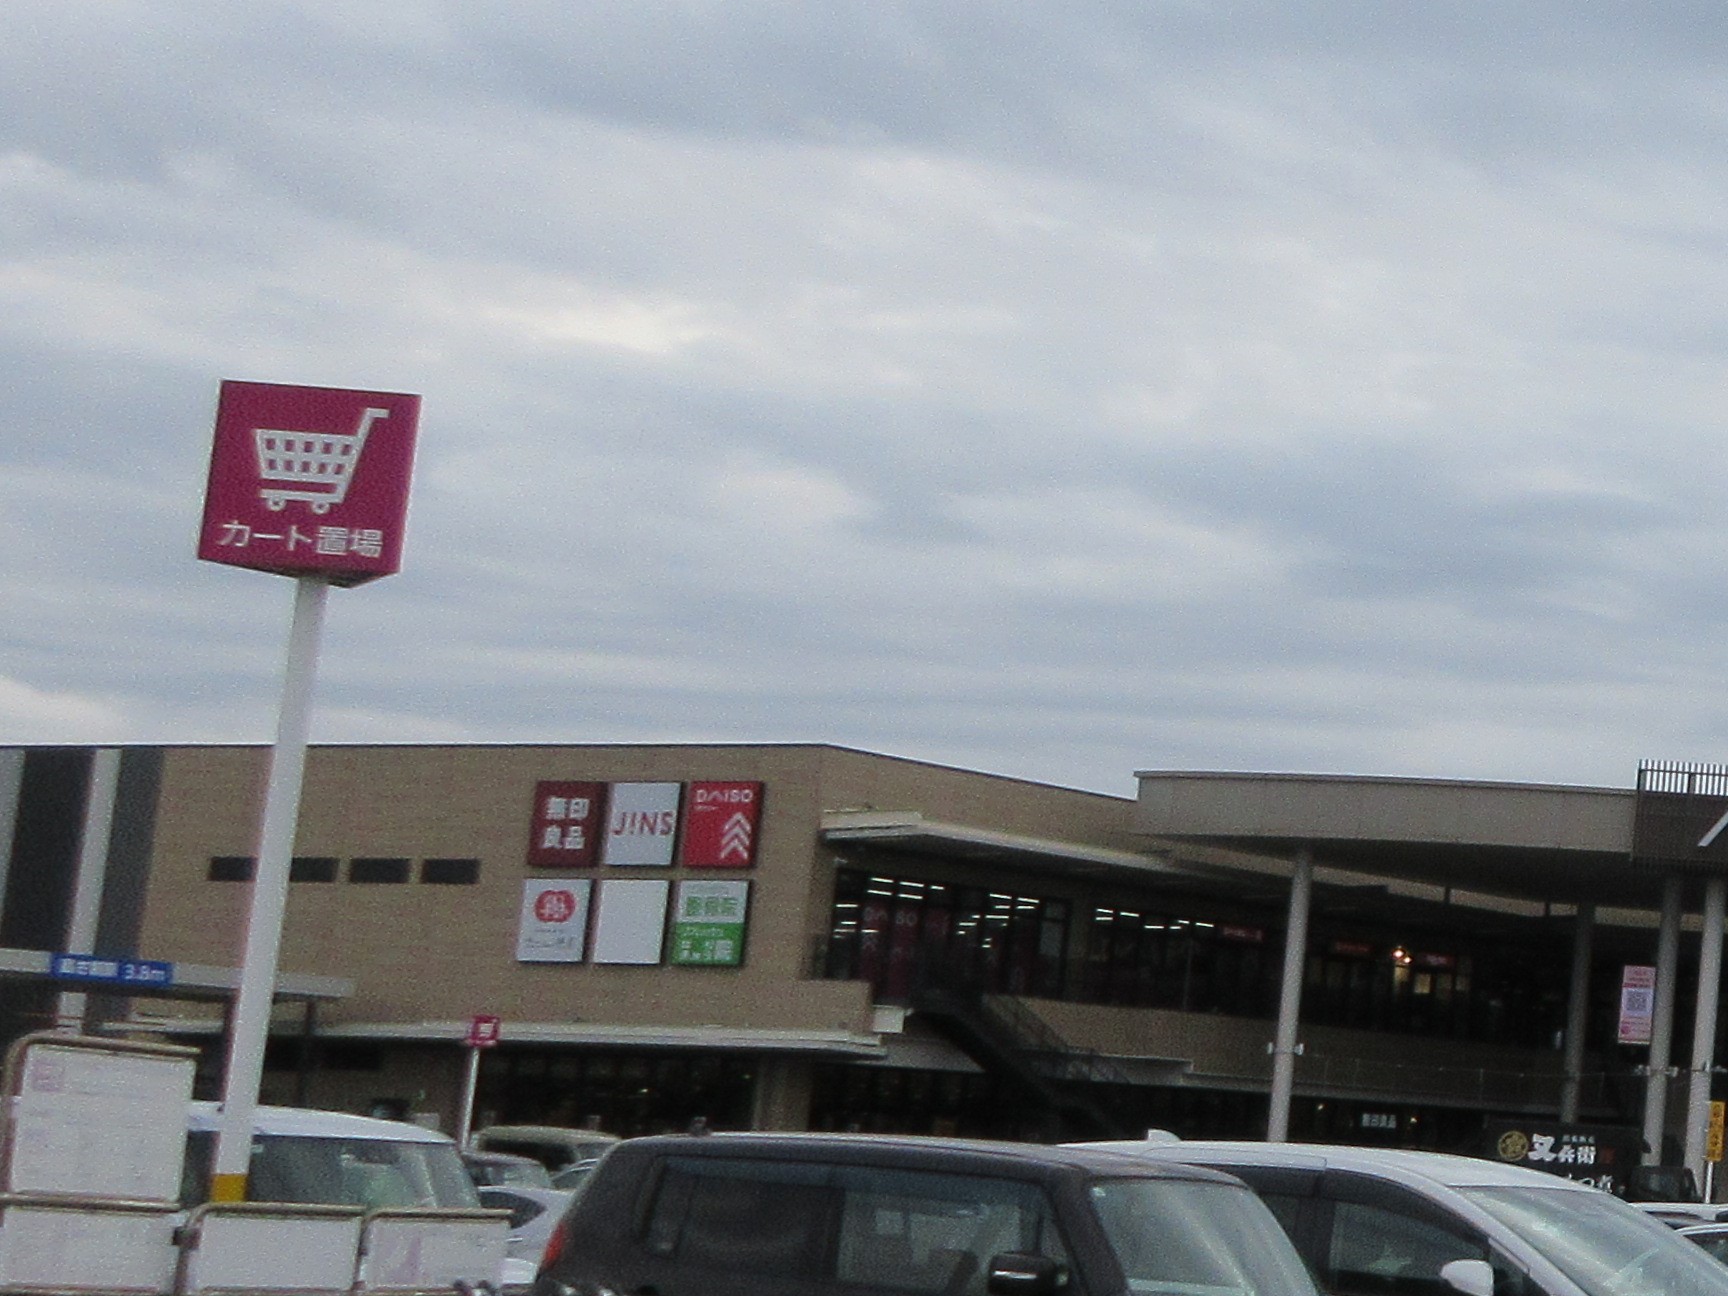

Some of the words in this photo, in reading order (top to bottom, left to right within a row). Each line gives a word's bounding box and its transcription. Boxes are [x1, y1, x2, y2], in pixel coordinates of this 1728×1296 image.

[217, 519, 384, 559] カート置場
[696, 789, 753, 803] DAISO
